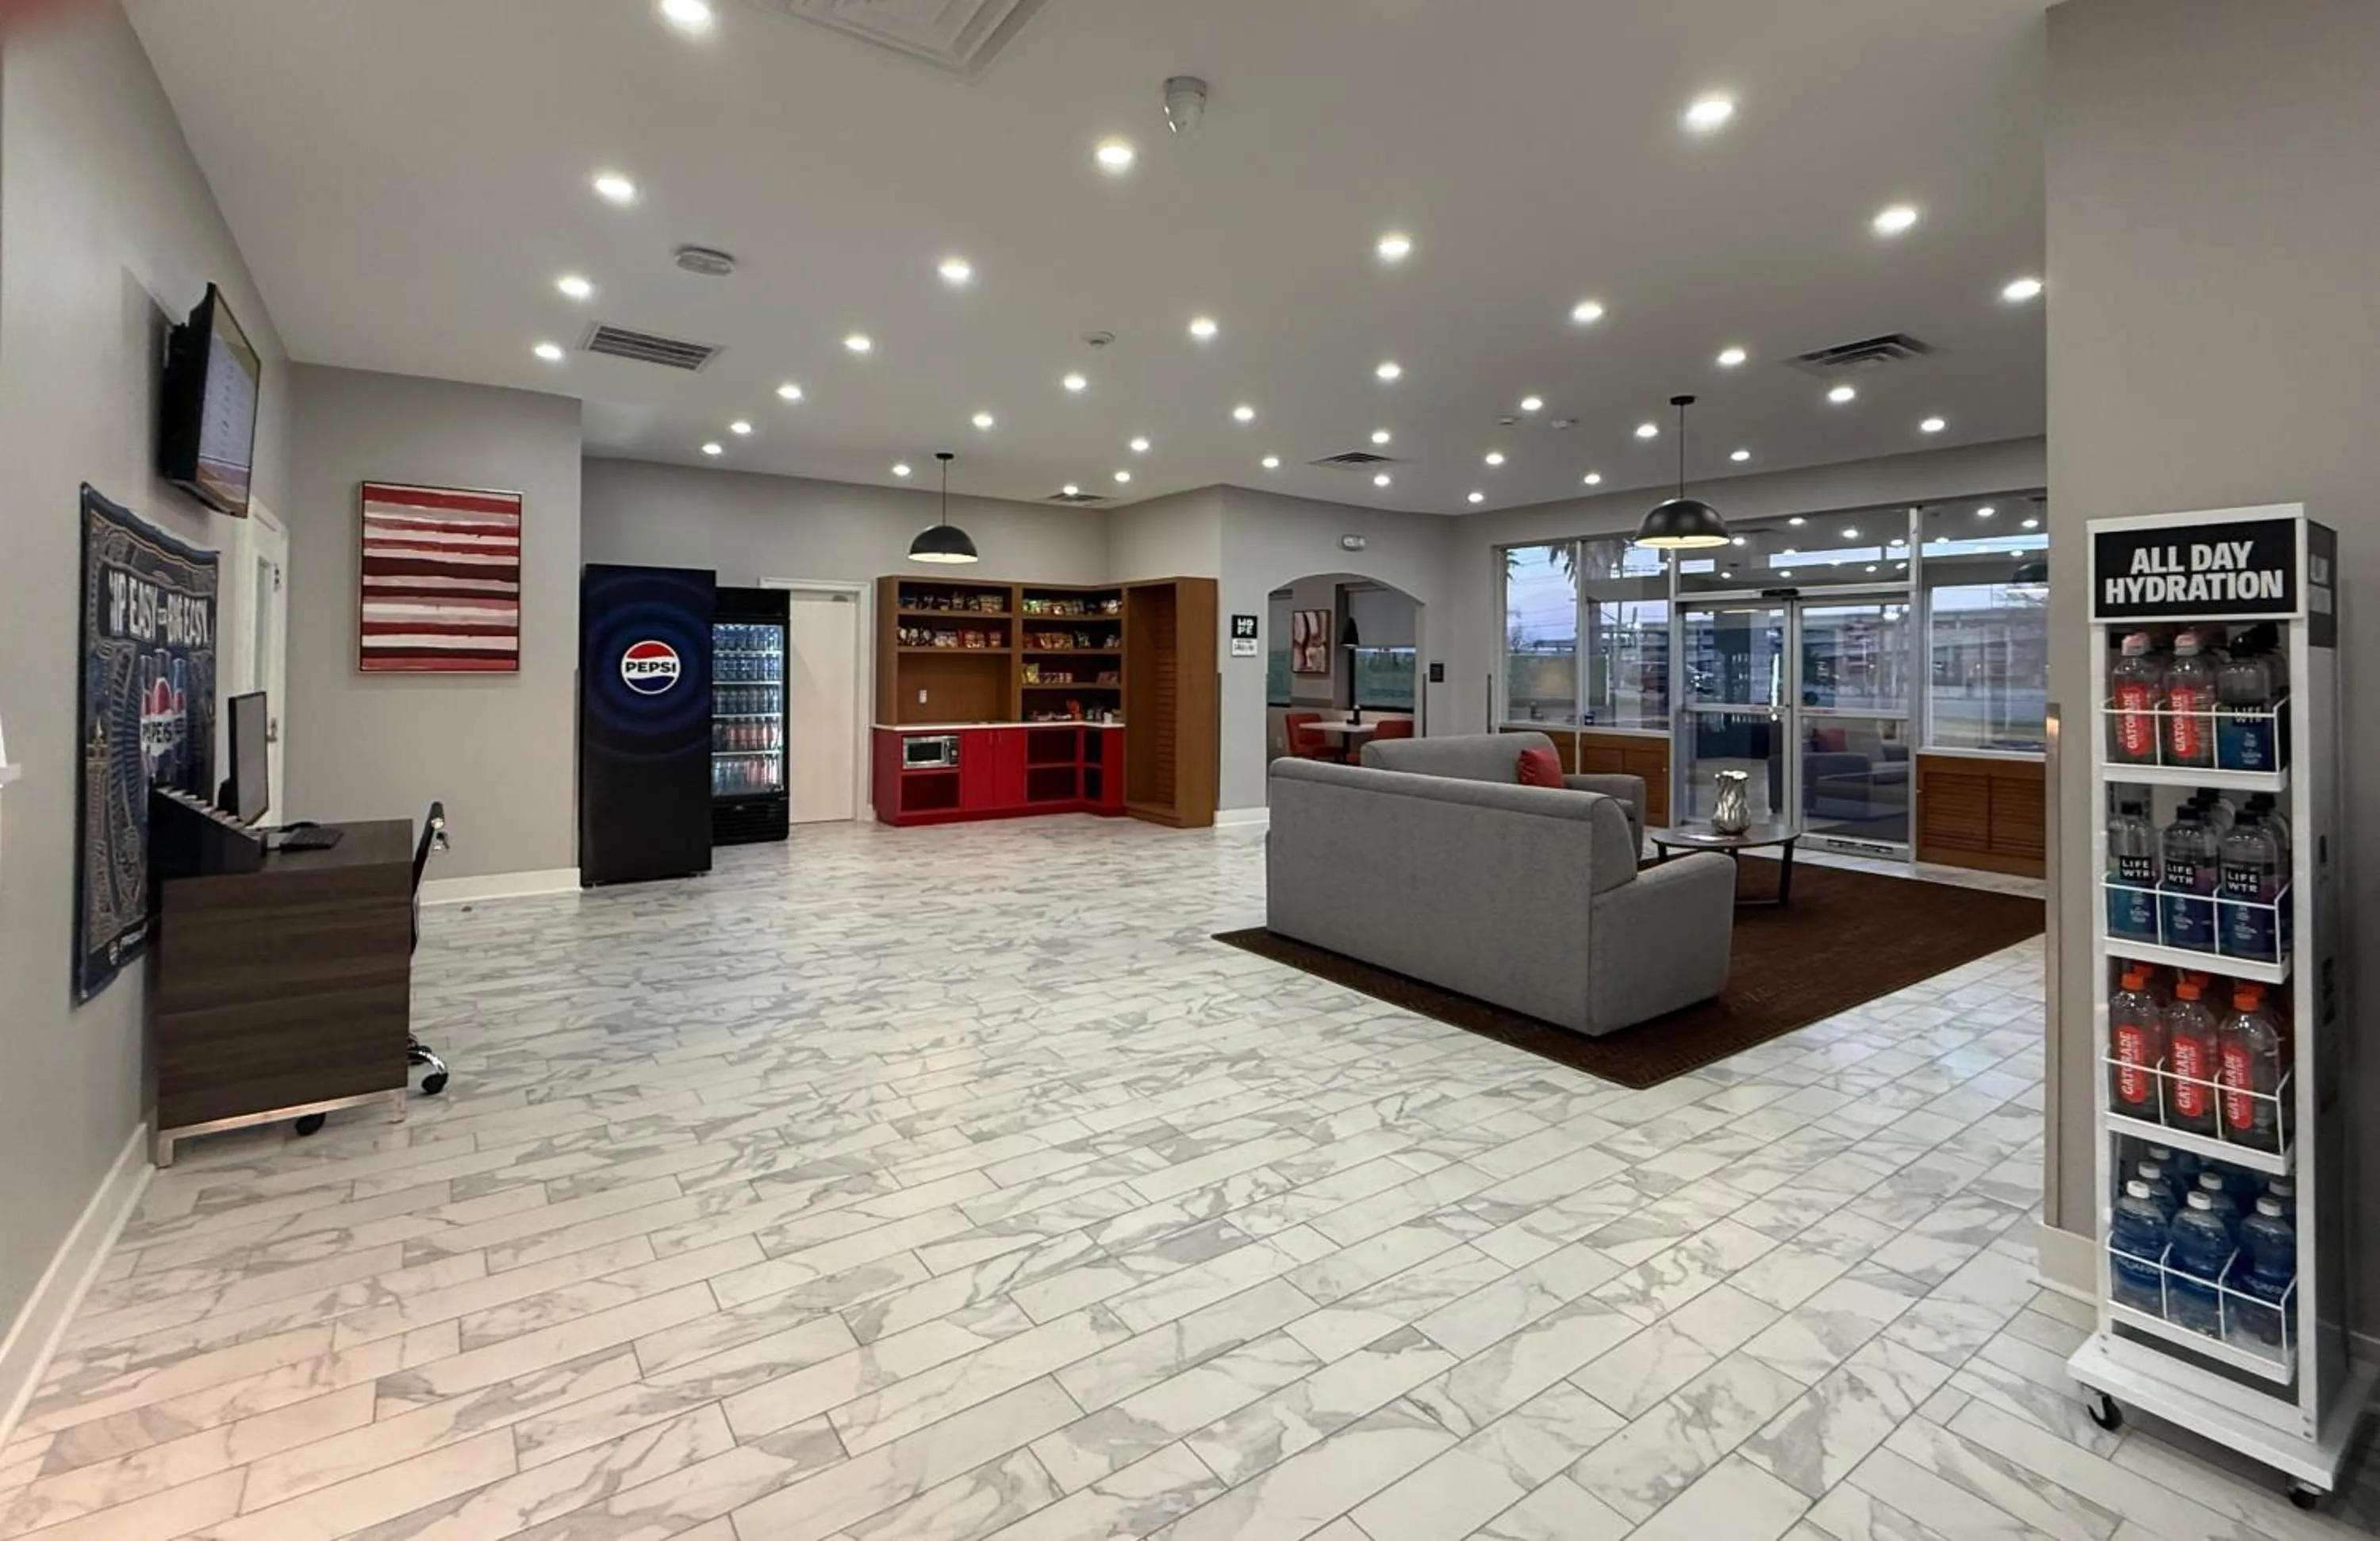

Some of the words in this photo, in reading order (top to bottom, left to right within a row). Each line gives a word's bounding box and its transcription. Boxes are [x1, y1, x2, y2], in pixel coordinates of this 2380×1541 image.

[2131, 545, 2184, 575] ALL
[2190, 540, 2254, 572] DAY
[2105, 569, 2284, 604] HYDRATION
[624, 660, 677, 674] PEPSI
[2121, 858, 2150, 869] LIFE
[2167, 863, 2194, 875] LIFE
[2121, 869, 2150, 878] WTR
[2167, 874, 2194, 885] WTR
[2227, 870, 2258, 883] LIFE
[2227, 882, 2258, 893] WTR
